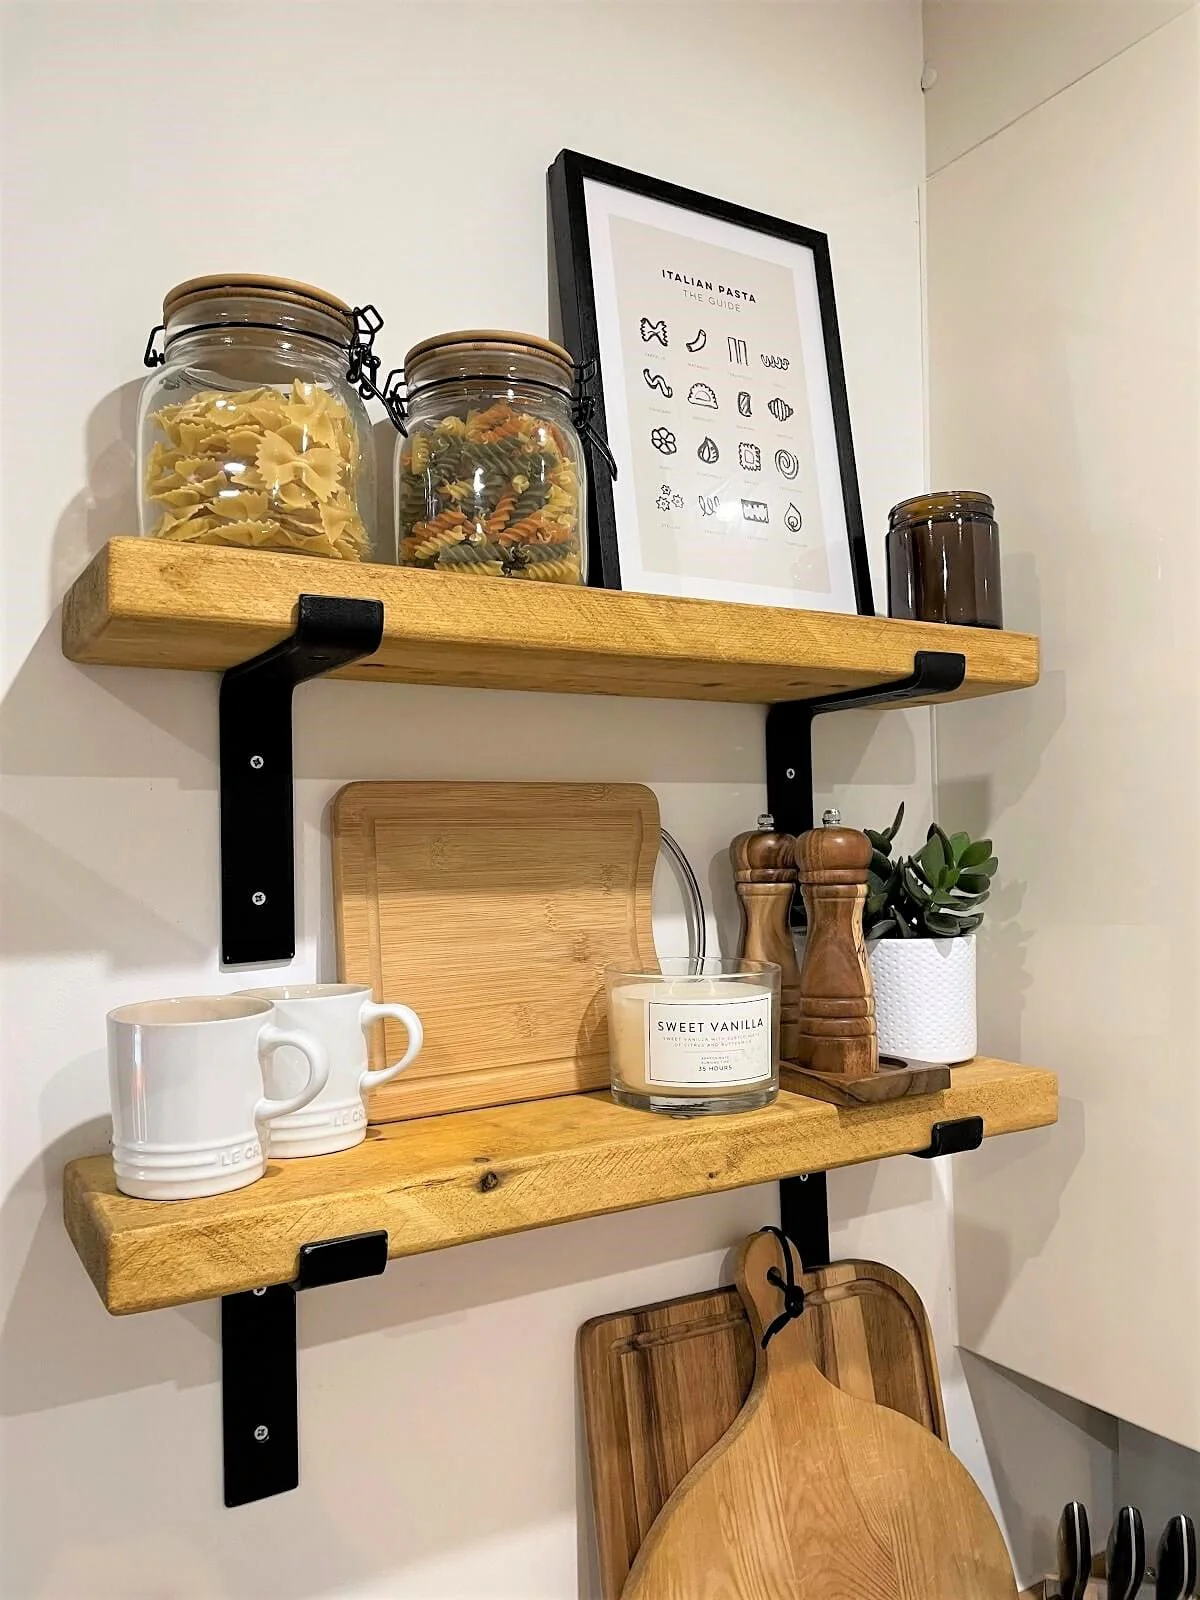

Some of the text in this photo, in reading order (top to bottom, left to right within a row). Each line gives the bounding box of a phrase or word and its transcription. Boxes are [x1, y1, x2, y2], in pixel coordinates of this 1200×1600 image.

[661, 269, 757, 303] ITALIAN PASTA
[683, 289, 742, 313] THE GUIDE
[657, 1018, 763, 1033] SWEET VANILLA
[708, 1064, 733, 1072] HOURS
[334, 1112, 349, 1128] LE
[221, 1150, 241, 1167] LE
